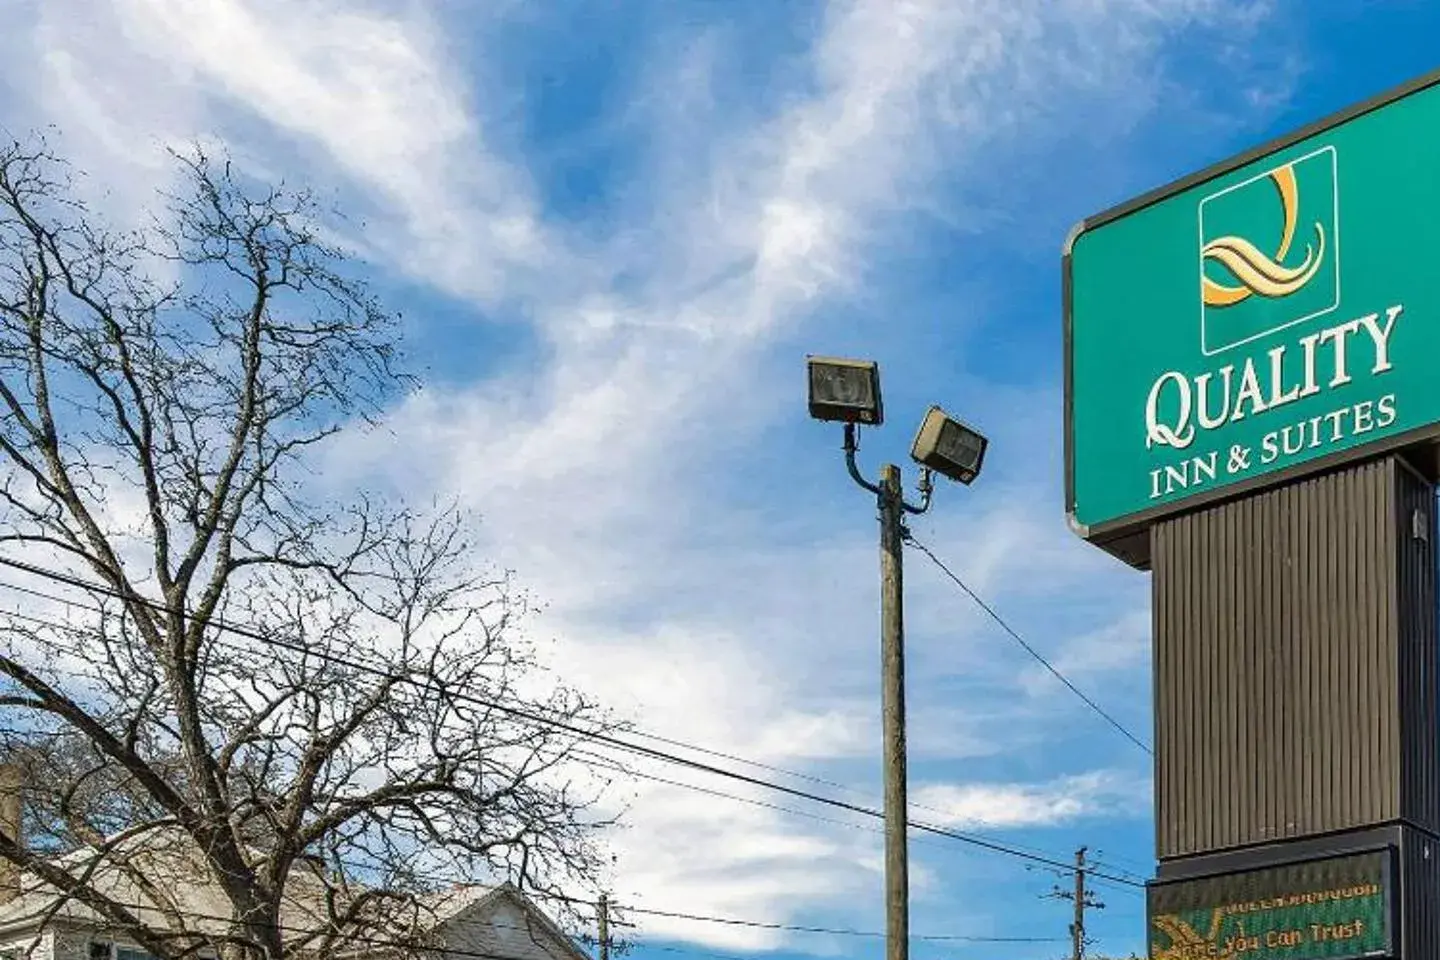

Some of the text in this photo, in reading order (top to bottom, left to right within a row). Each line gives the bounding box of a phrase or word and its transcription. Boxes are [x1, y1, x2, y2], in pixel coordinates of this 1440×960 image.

[1145, 304, 1403, 449] QUALITY
[1150, 394, 1396, 499] INN & SUITES
[1266, 930, 1300, 948] Can
[1311, 919, 1363, 941] Trust
